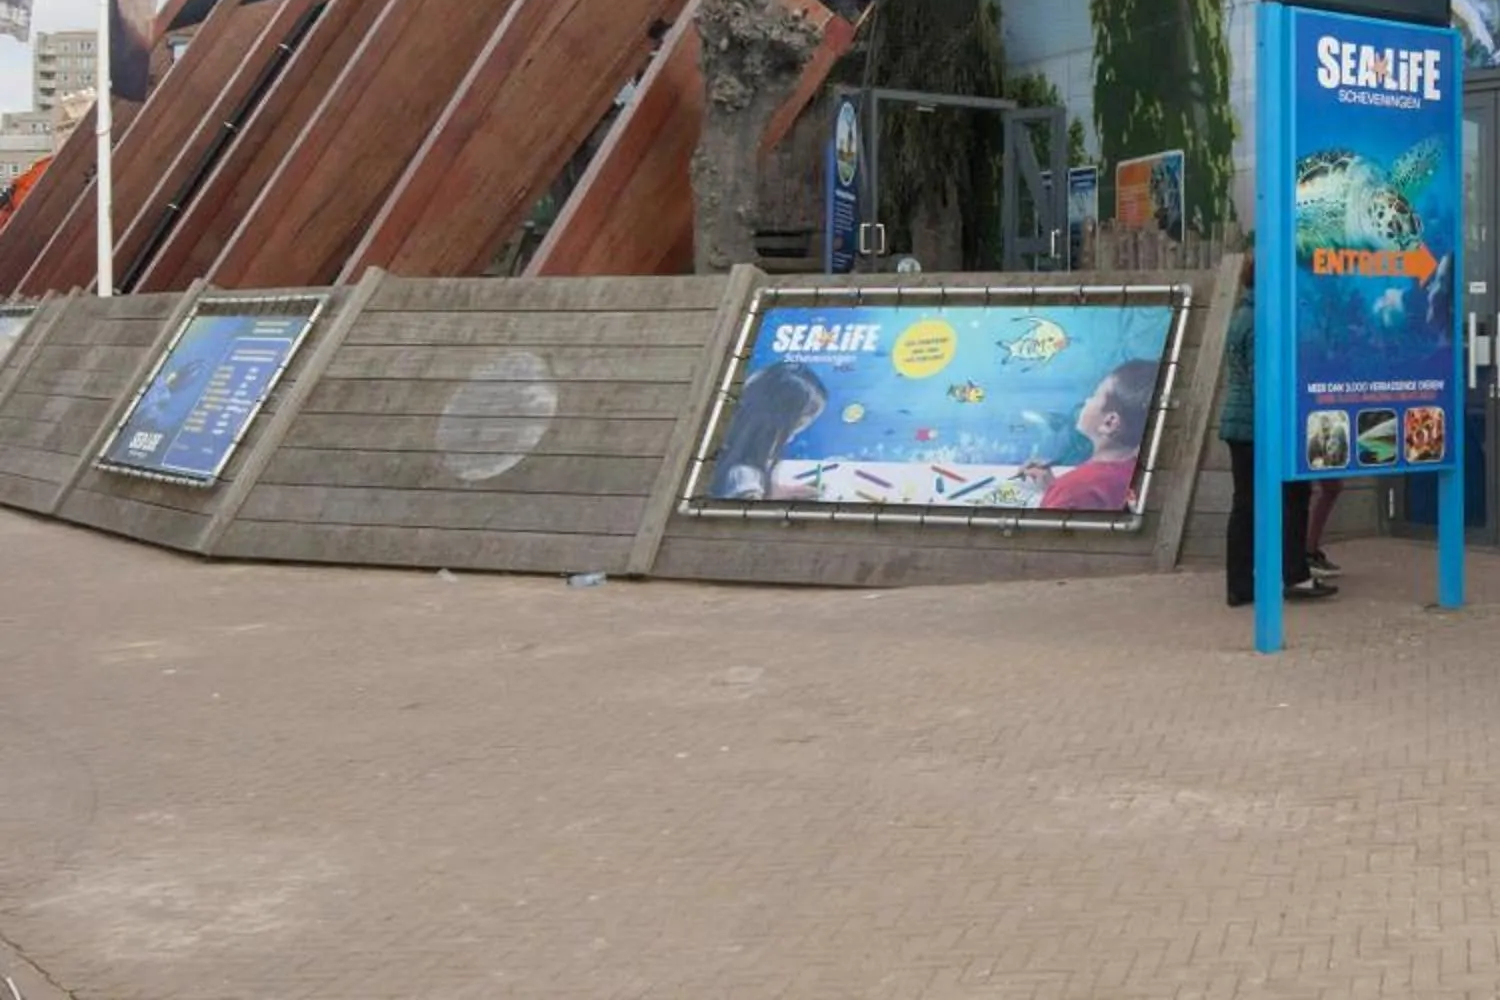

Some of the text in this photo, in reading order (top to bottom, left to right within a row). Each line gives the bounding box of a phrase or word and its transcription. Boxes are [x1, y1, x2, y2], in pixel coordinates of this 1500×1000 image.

[1317, 35, 1377, 89] SEA
[1338, 89, 1421, 109] SCHEVENINGEN
[773, 324, 825, 353] SEA
